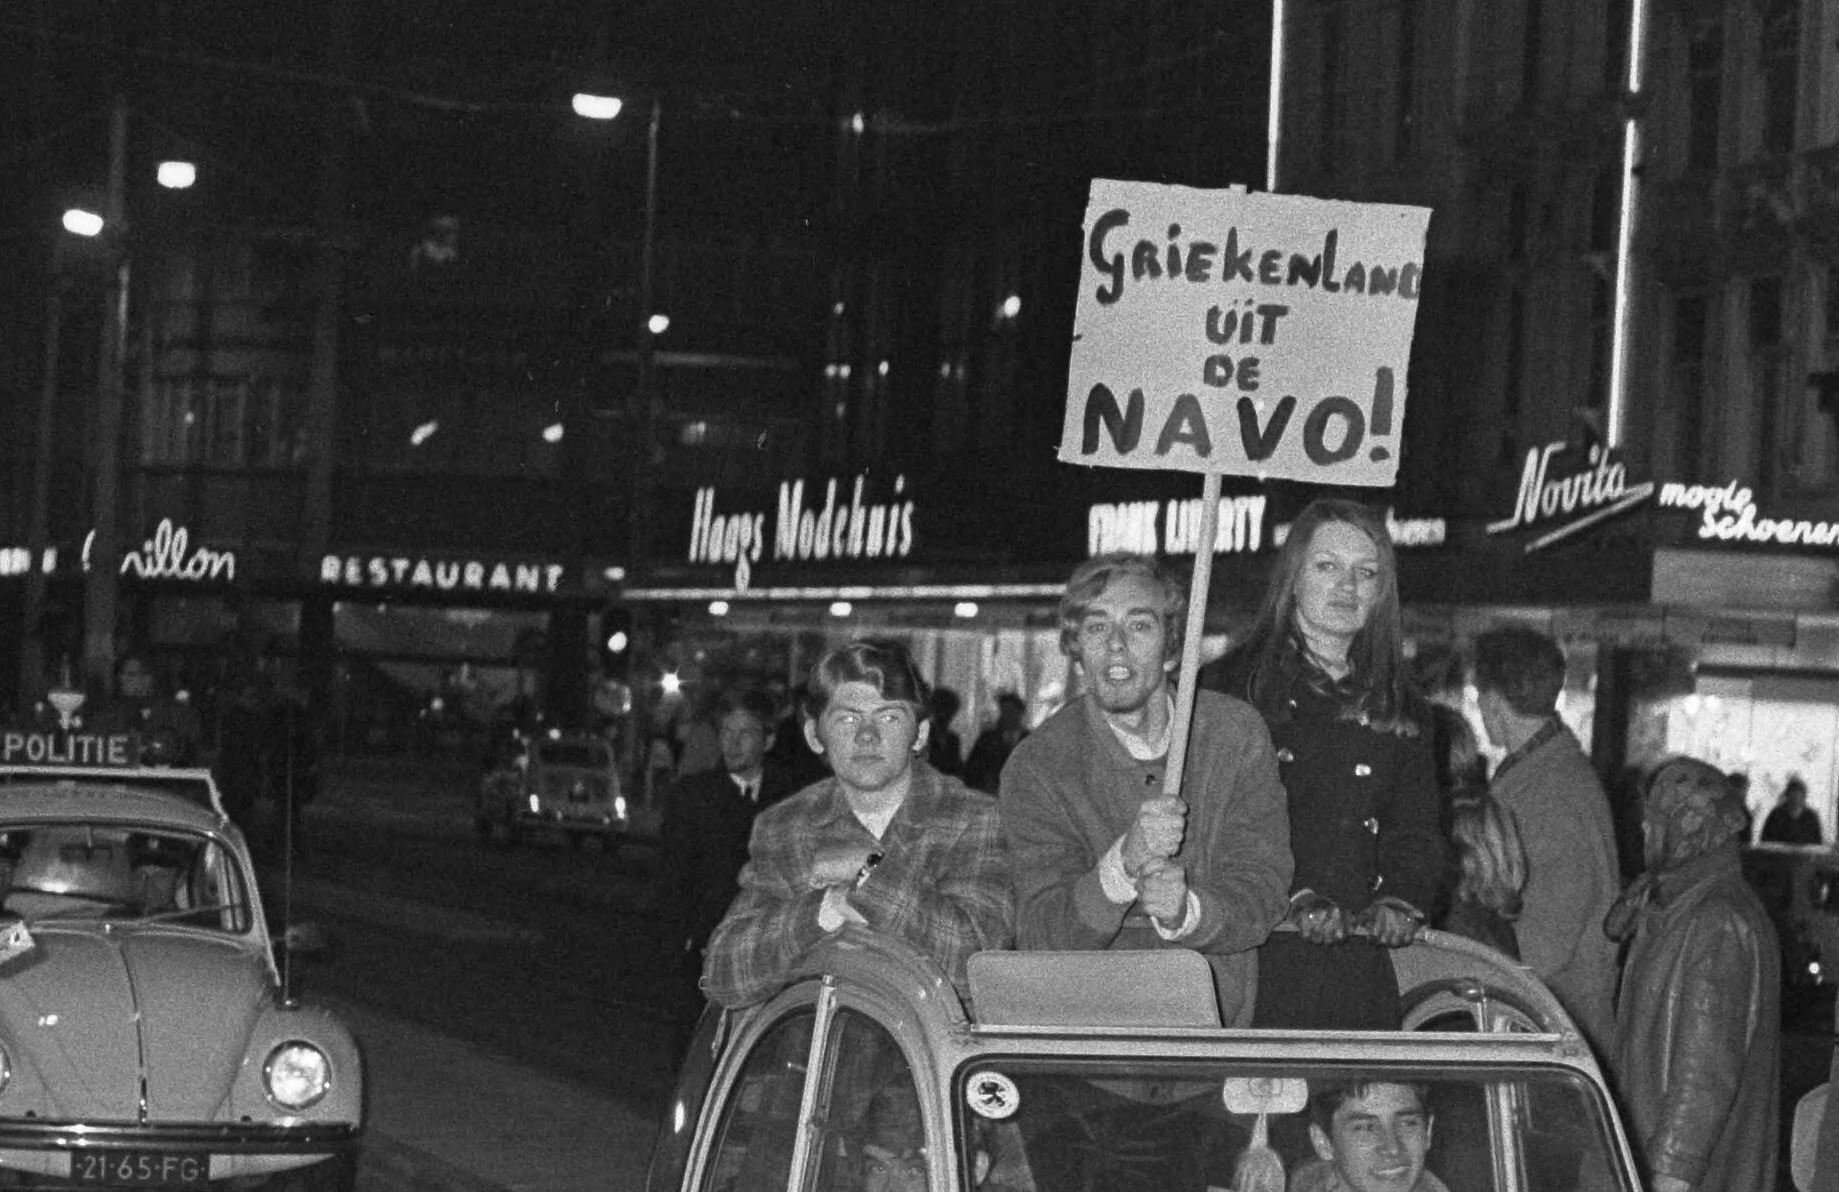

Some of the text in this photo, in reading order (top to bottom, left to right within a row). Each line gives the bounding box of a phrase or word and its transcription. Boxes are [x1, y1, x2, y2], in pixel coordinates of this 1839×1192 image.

[1203, 355, 1260, 391] DE
[1081, 366, 1395, 467] NAVO!
[1486, 440, 1654, 534] Novita
[772, 473, 915, 562] Modehuis
[1164, 495, 1266, 555] LIBRTY
[320, 554, 564, 593] RESTAURANT
[3, 732, 129, 764] POLITIE
